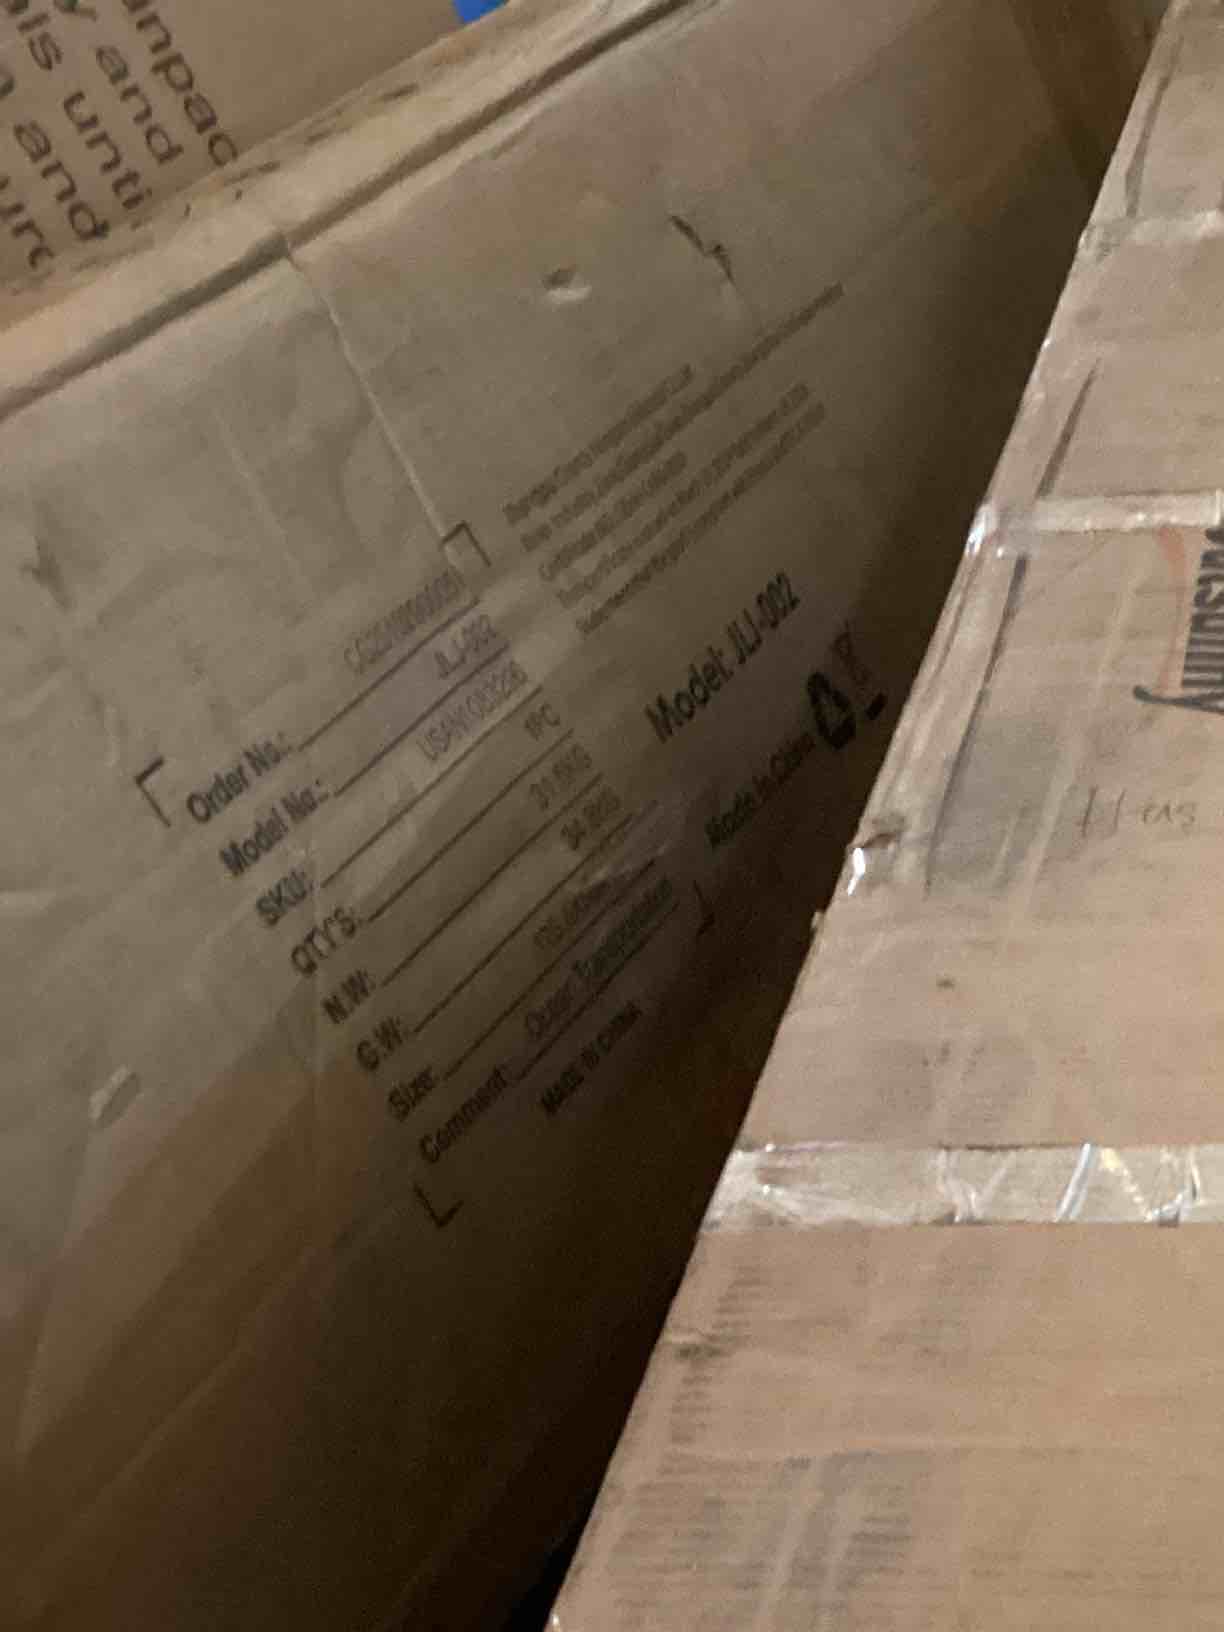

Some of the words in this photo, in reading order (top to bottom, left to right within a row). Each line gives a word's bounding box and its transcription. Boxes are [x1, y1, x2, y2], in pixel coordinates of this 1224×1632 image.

[95, 45, 184, 165] and
[13, 120, 110, 241] and
[62, 90, 153, 230] unti
[186, 765, 250, 825] Order
[219, 807, 289, 879] Model
[1075, 785, 1199, 838] Has
